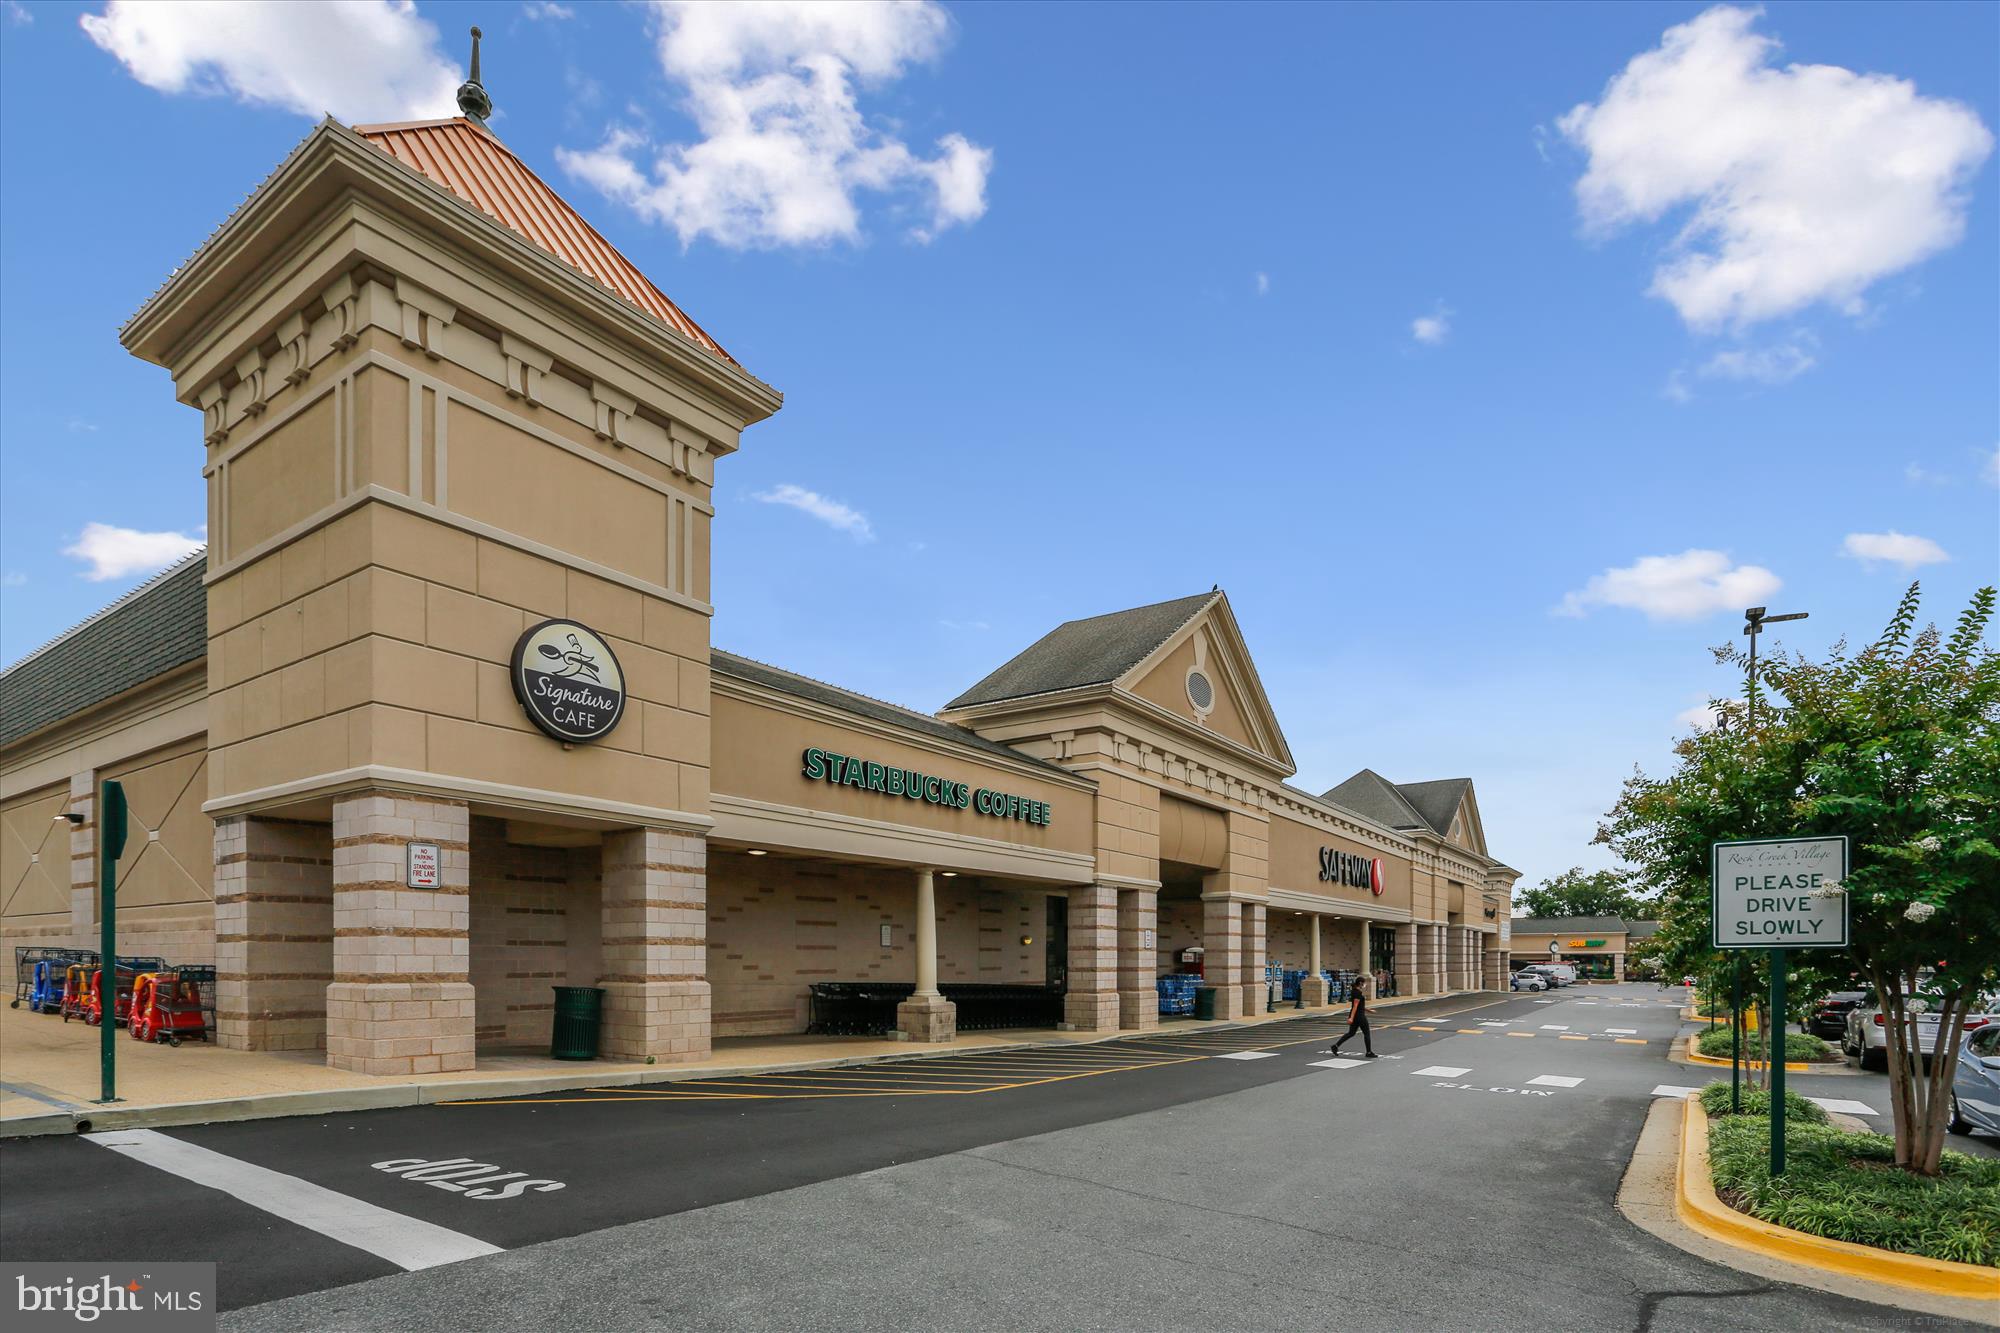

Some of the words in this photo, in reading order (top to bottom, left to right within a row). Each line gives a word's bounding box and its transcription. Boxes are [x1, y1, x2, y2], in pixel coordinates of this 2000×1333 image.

[533, 676, 614, 711] Signature
[552, 706, 596, 729] CAFE
[803, 747, 970, 810] STARBUCKS
[974, 787, 1051, 826] COFFEE
[1728, 851, 1757, 864] Rock
[1758, 849, 1790, 862] Creek
[1794, 845, 1832, 866] Village
[1320, 846, 1373, 889] SAFEWAY
[1735, 873, 1825, 892] PLEASE
[1746, 896, 1812, 913] DRIVE
[1735, 918, 1825, 936] SLOWLY
[1431, 1082, 1556, 1097] SLOW
[370, 1156, 567, 1201] STOP
